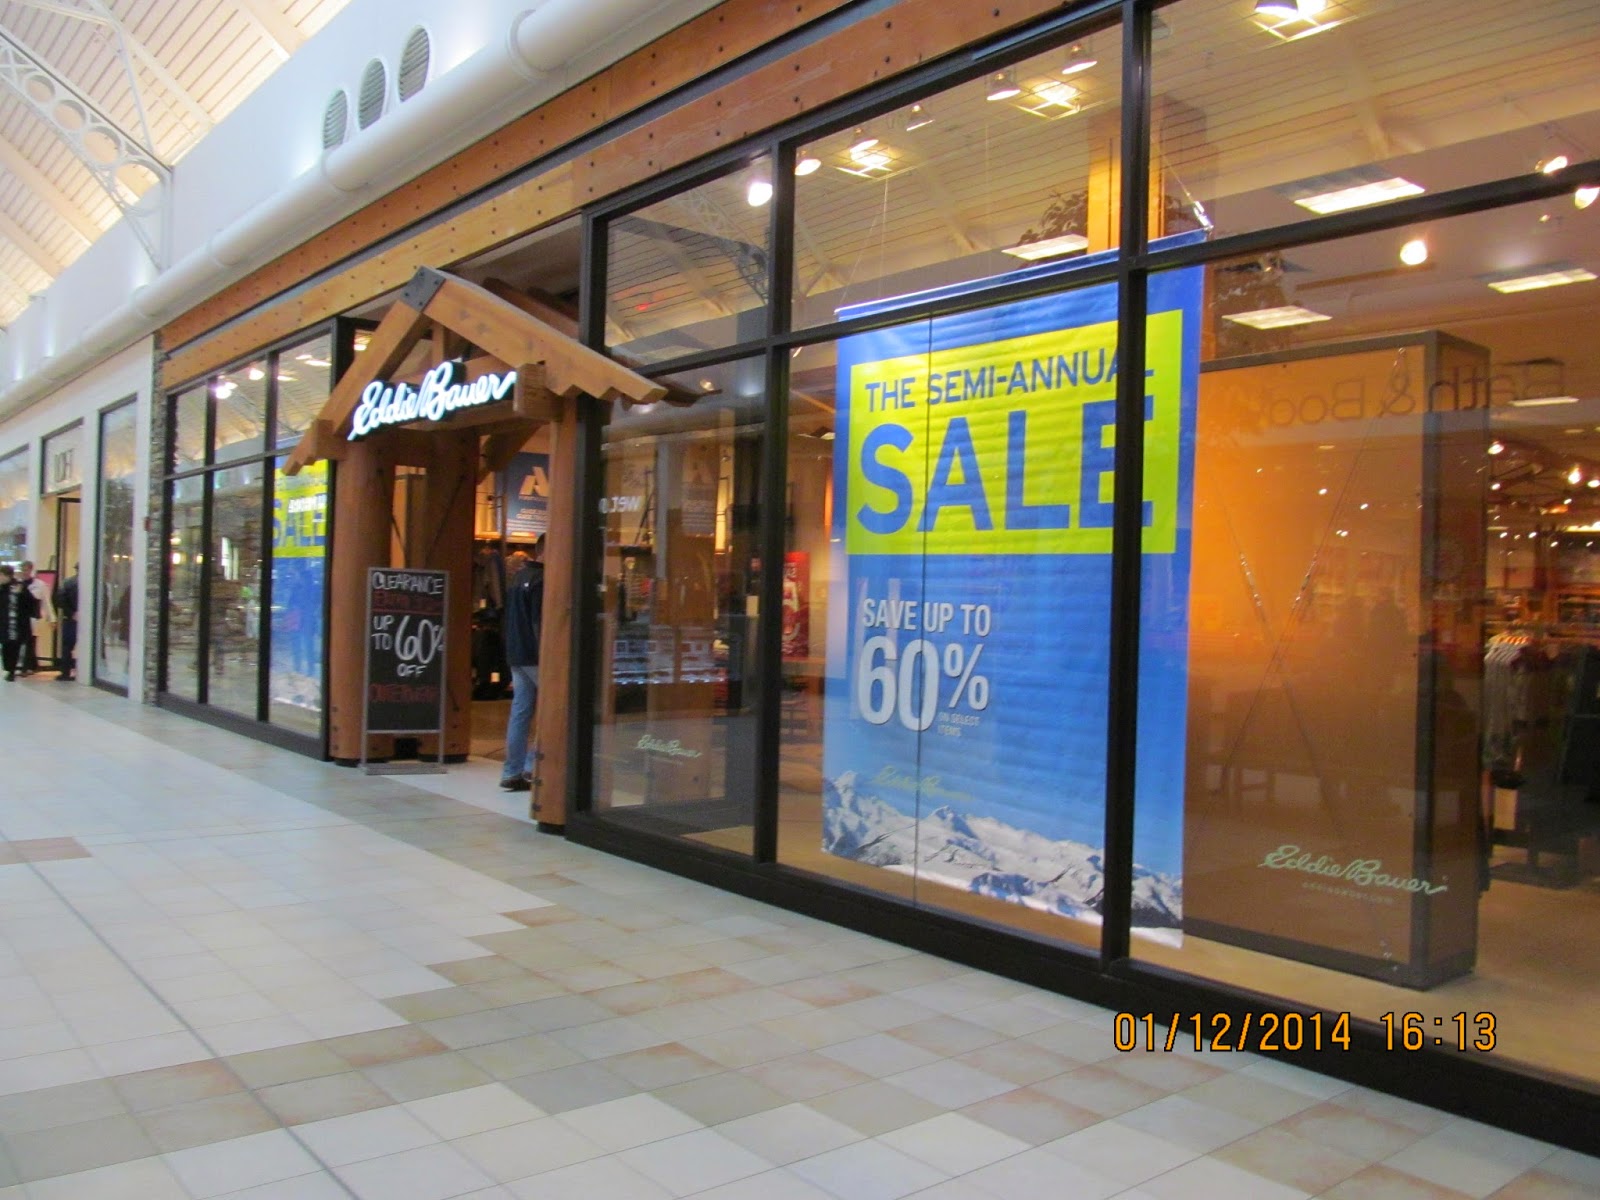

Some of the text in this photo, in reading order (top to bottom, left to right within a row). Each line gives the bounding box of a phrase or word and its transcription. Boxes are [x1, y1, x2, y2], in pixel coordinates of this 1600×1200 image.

[347, 361, 517, 441] Eddie Bauer
[865, 348, 1154, 412] THE SEMI-ANNUA
[856, 395, 1154, 535] SALE
[372, 571, 443, 595] CLEARANCE
[371, 614, 444, 665] TO 60%
[373, 614, 395, 630] UP
[862, 598, 992, 637] SAVE UP TO
[396, 662, 428, 677] OFF
[857, 635, 990, 732] 60%
[1257, 844, 1342, 877] Eddie
[1340, 858, 1448, 895] Bauer
